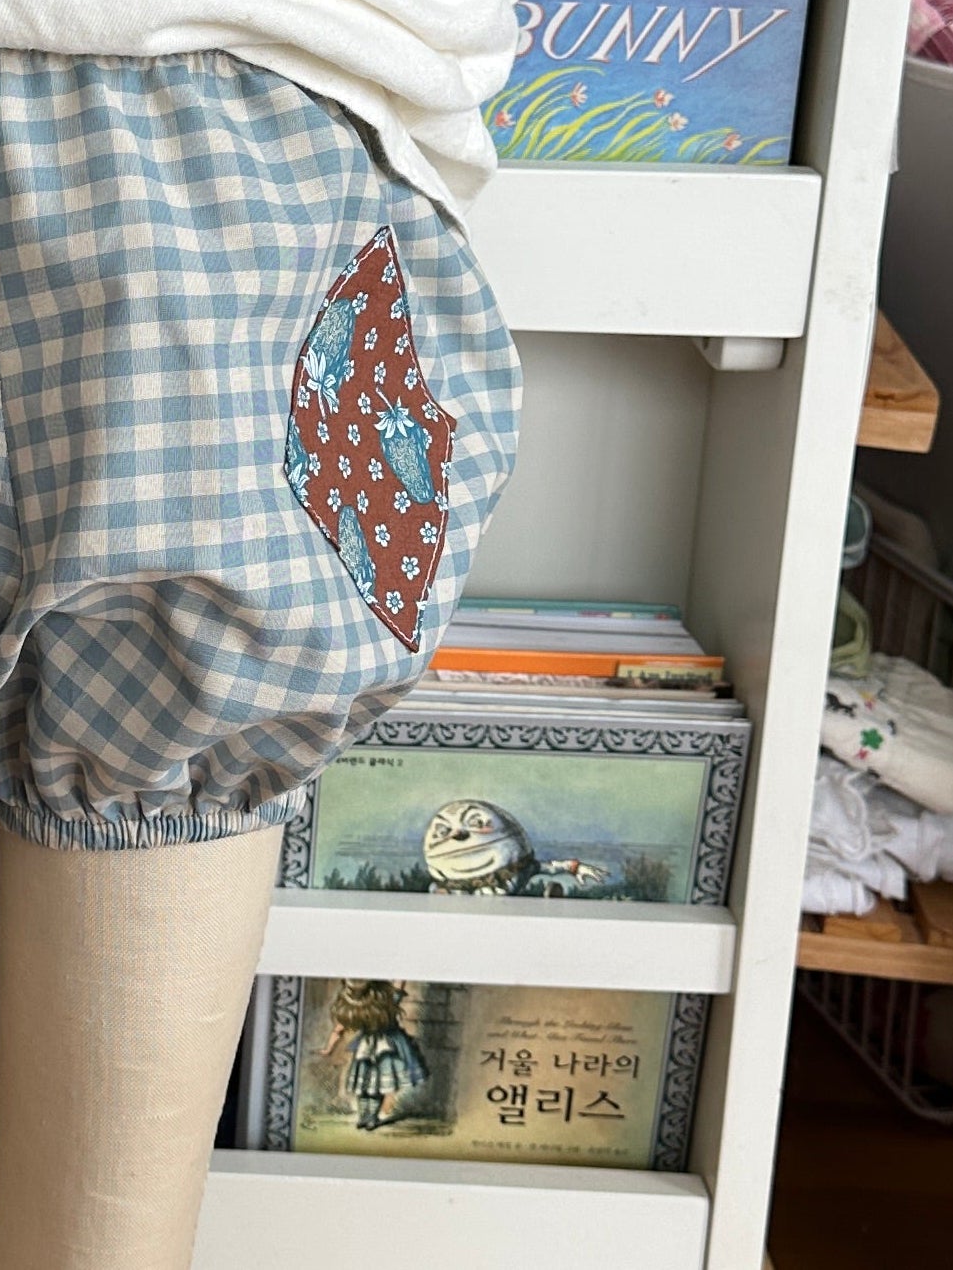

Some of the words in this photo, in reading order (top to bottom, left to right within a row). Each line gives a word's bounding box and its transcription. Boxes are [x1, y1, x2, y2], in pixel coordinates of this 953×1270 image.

[514, 0, 791, 84] BUNNY
[480, 1048, 539, 1077] 거울
[553, 1051, 641, 1079] 나라의
[486, 1084, 625, 1126] 앨리스
